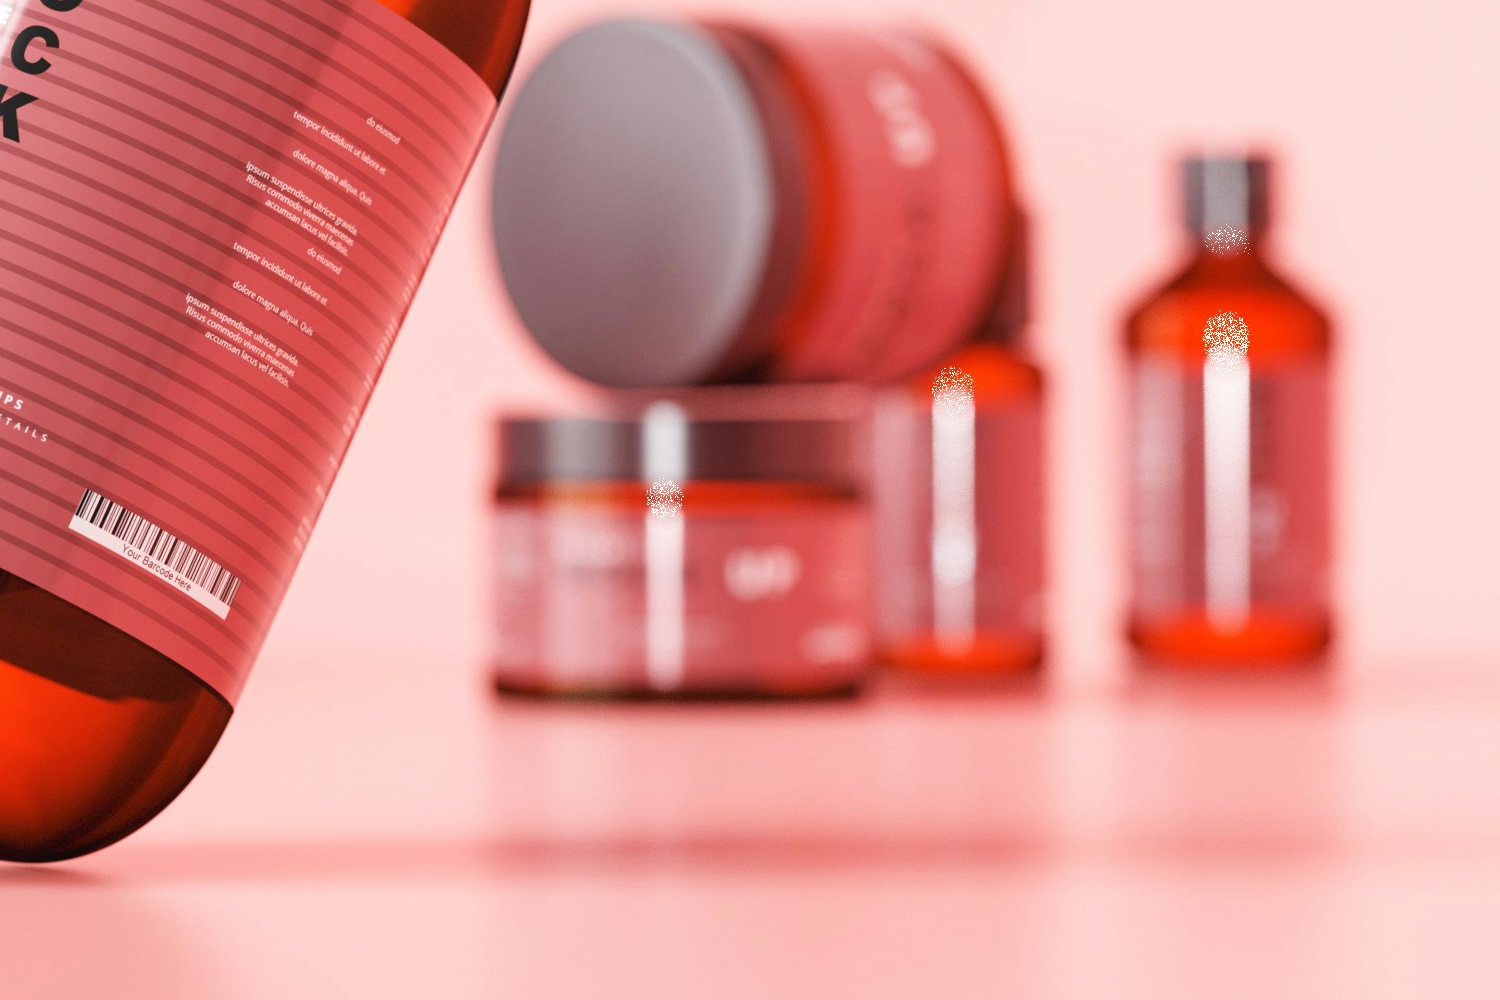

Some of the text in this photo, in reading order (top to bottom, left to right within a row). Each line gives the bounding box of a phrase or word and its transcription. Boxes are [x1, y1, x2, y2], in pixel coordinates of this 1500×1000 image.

[293, 110, 321, 132] tempor
[353, 148, 362, 159] ut
[360, 151, 380, 171] labore
[366, 116, 376, 128] do
[292, 149, 316, 168] dolore
[316, 163, 339, 181] magna
[245, 173, 267, 191] Risus
[266, 187, 303, 212] commodo
[303, 206, 325, 227] viverra
[265, 199, 300, 225] accumsan
[300, 217, 318, 236] lacus
[318, 229, 328, 243] vel
[270, 175, 313, 206] suspendisse
[312, 201, 337, 221] ultrices
[233, 241, 261, 260] tempor
[294, 279, 303, 289] ut
[301, 282, 321, 302] labore
[306, 246, 317, 258] do
[209, 307, 254, 337] suspendisse
[253, 333, 277, 352] ultrices
[232, 280, 257, 299] dolore
[256, 294, 280, 313] magna
[299, 321, 314, 336] Quis
[185, 305, 295, 377] Risus commodo viverra maecenas
[205, 330, 240, 356] accumsan
[240, 349, 259, 367] lacus
[258, 361, 269, 373] vel
[122, 543, 192, 592] Your Barcode Here
